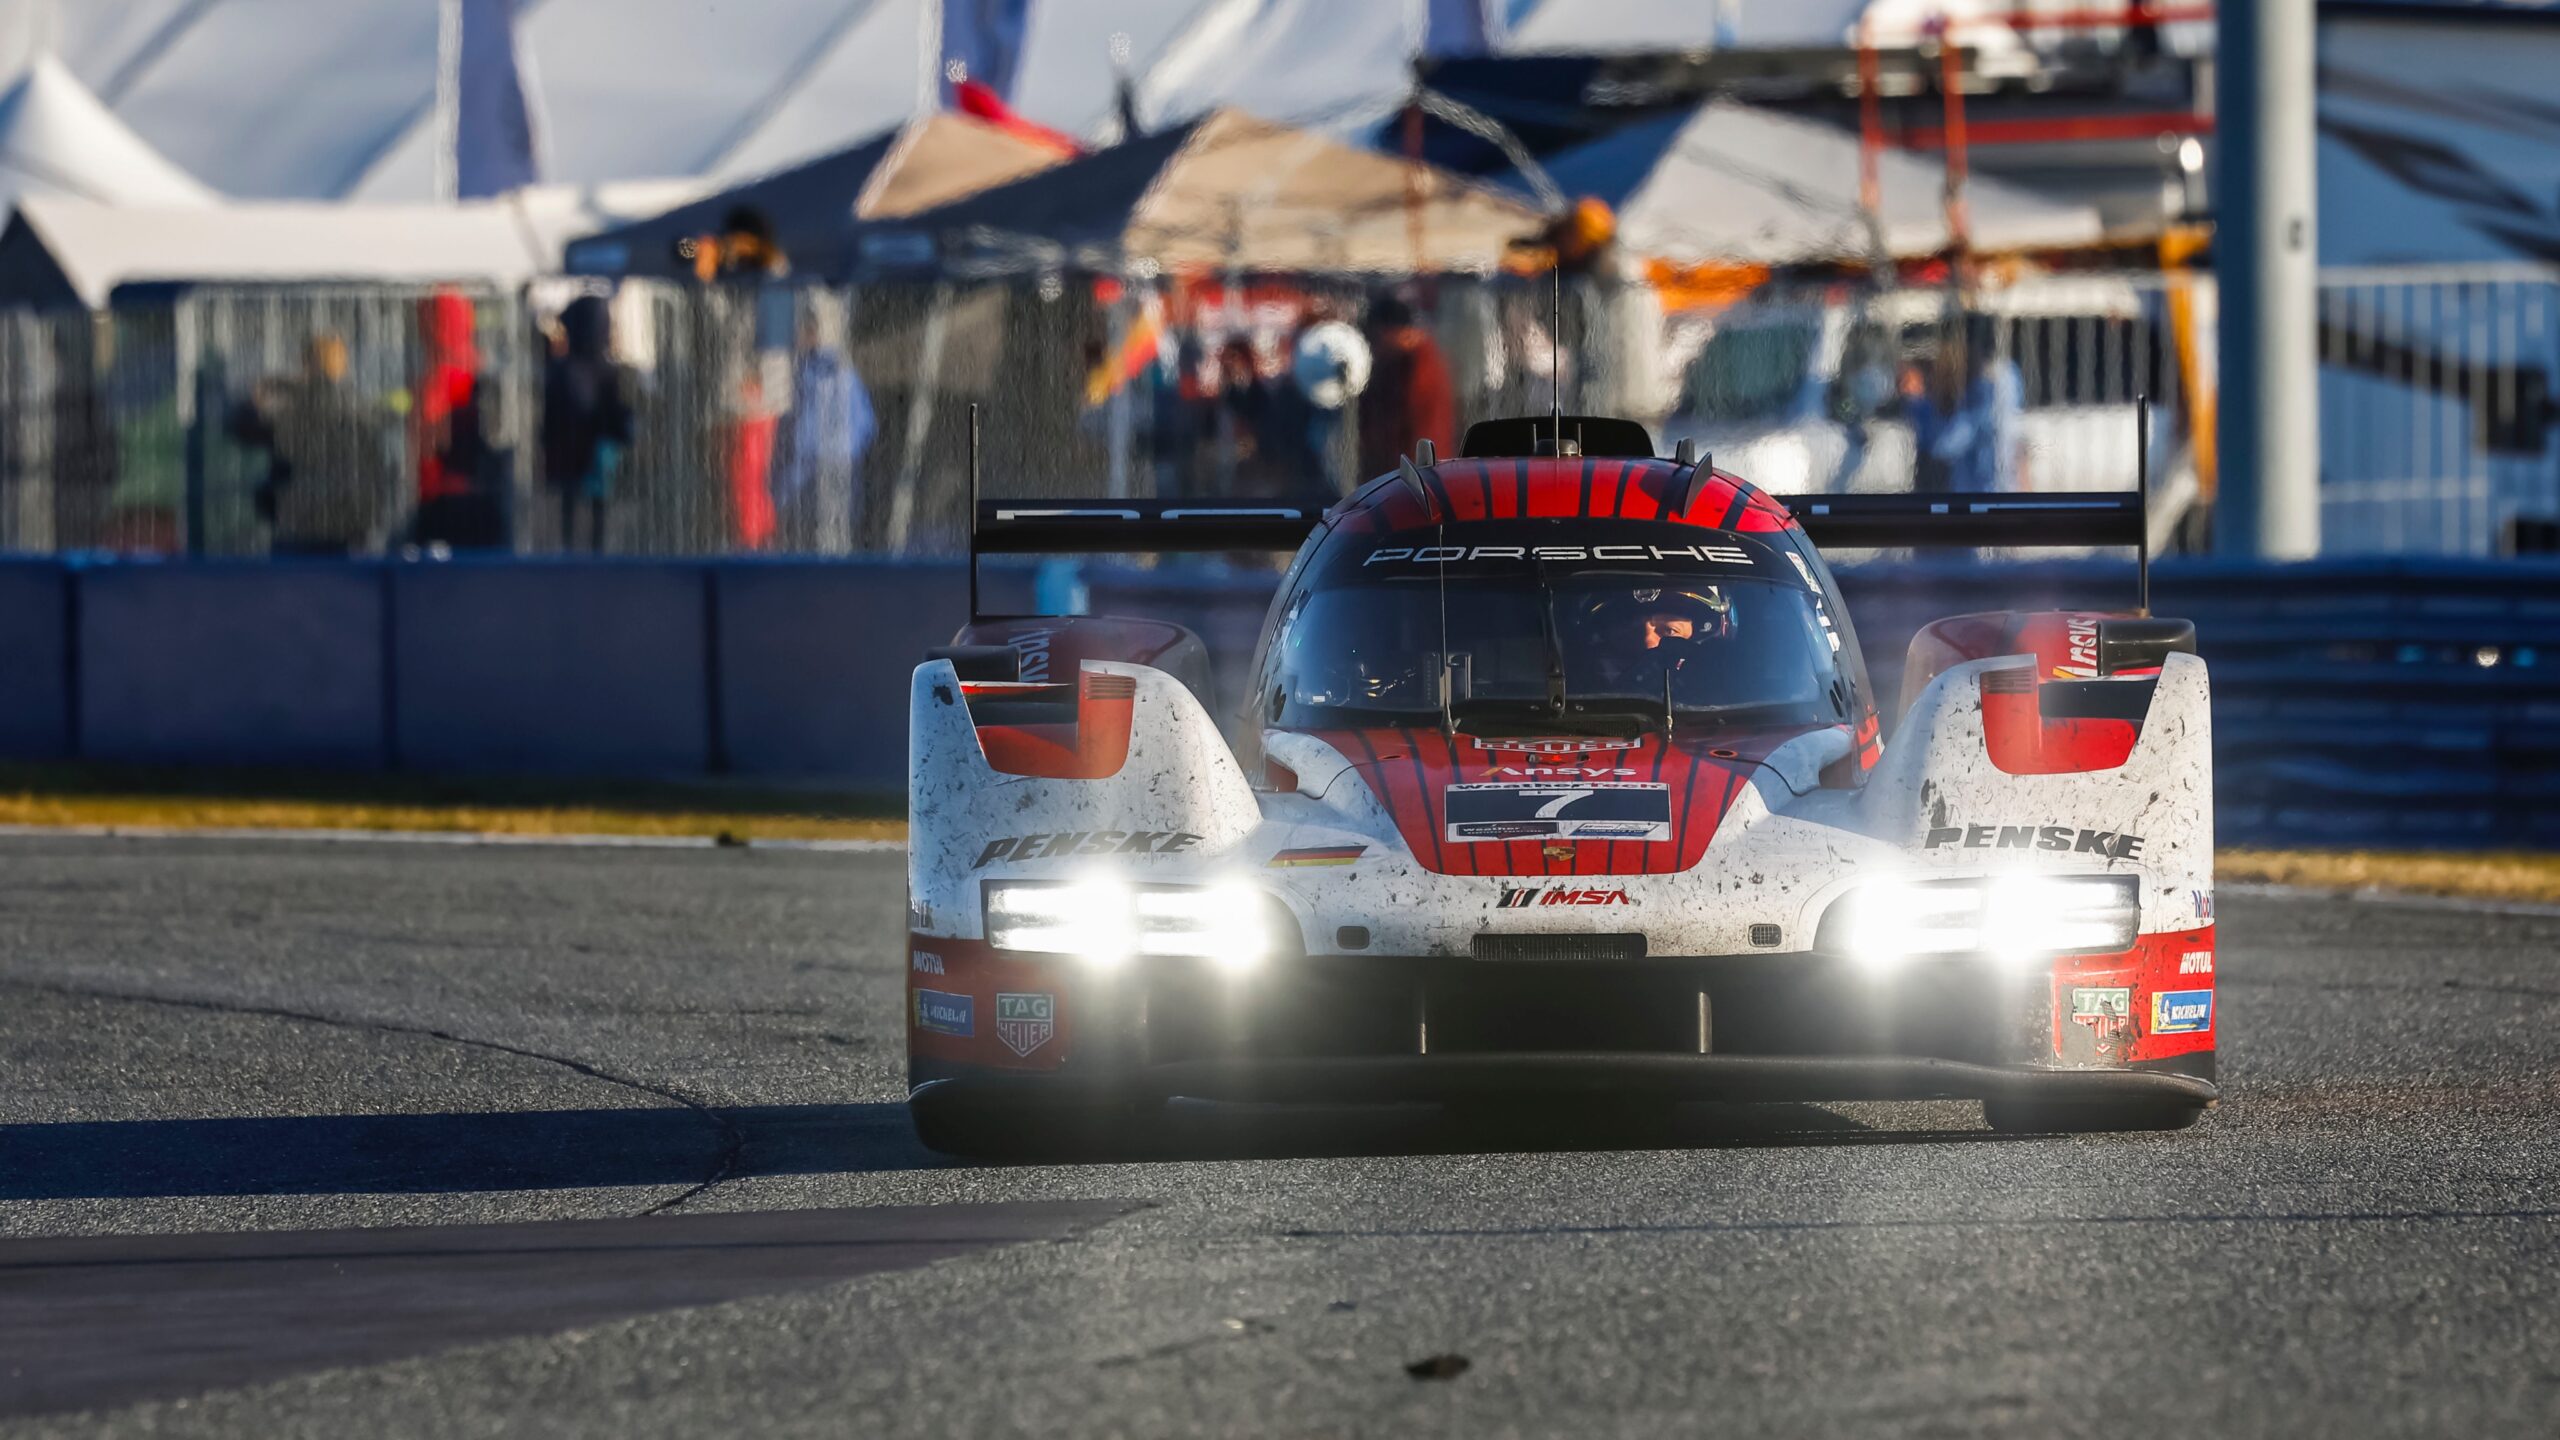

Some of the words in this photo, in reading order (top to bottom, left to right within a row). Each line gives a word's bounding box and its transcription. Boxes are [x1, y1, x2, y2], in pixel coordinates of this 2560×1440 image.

[1362, 546, 1754, 566] PORSCHE
[1479, 767, 1637, 777] Ansys
[1519, 790, 1594, 818] 7
[971, 831, 1204, 870] PENSKE
[1924, 826, 2145, 860] PENSKE
[1539, 891, 1629, 905] IMSA
[913, 951, 945, 976] MOTUL
[2180, 952, 2213, 975] MOTUL
[1000, 998, 1047, 1017] TAG
[2078, 993, 2125, 1012] TAG
[2171, 1004, 2207, 1020] MICHELIN
[1000, 1023, 1048, 1052] HEUER
